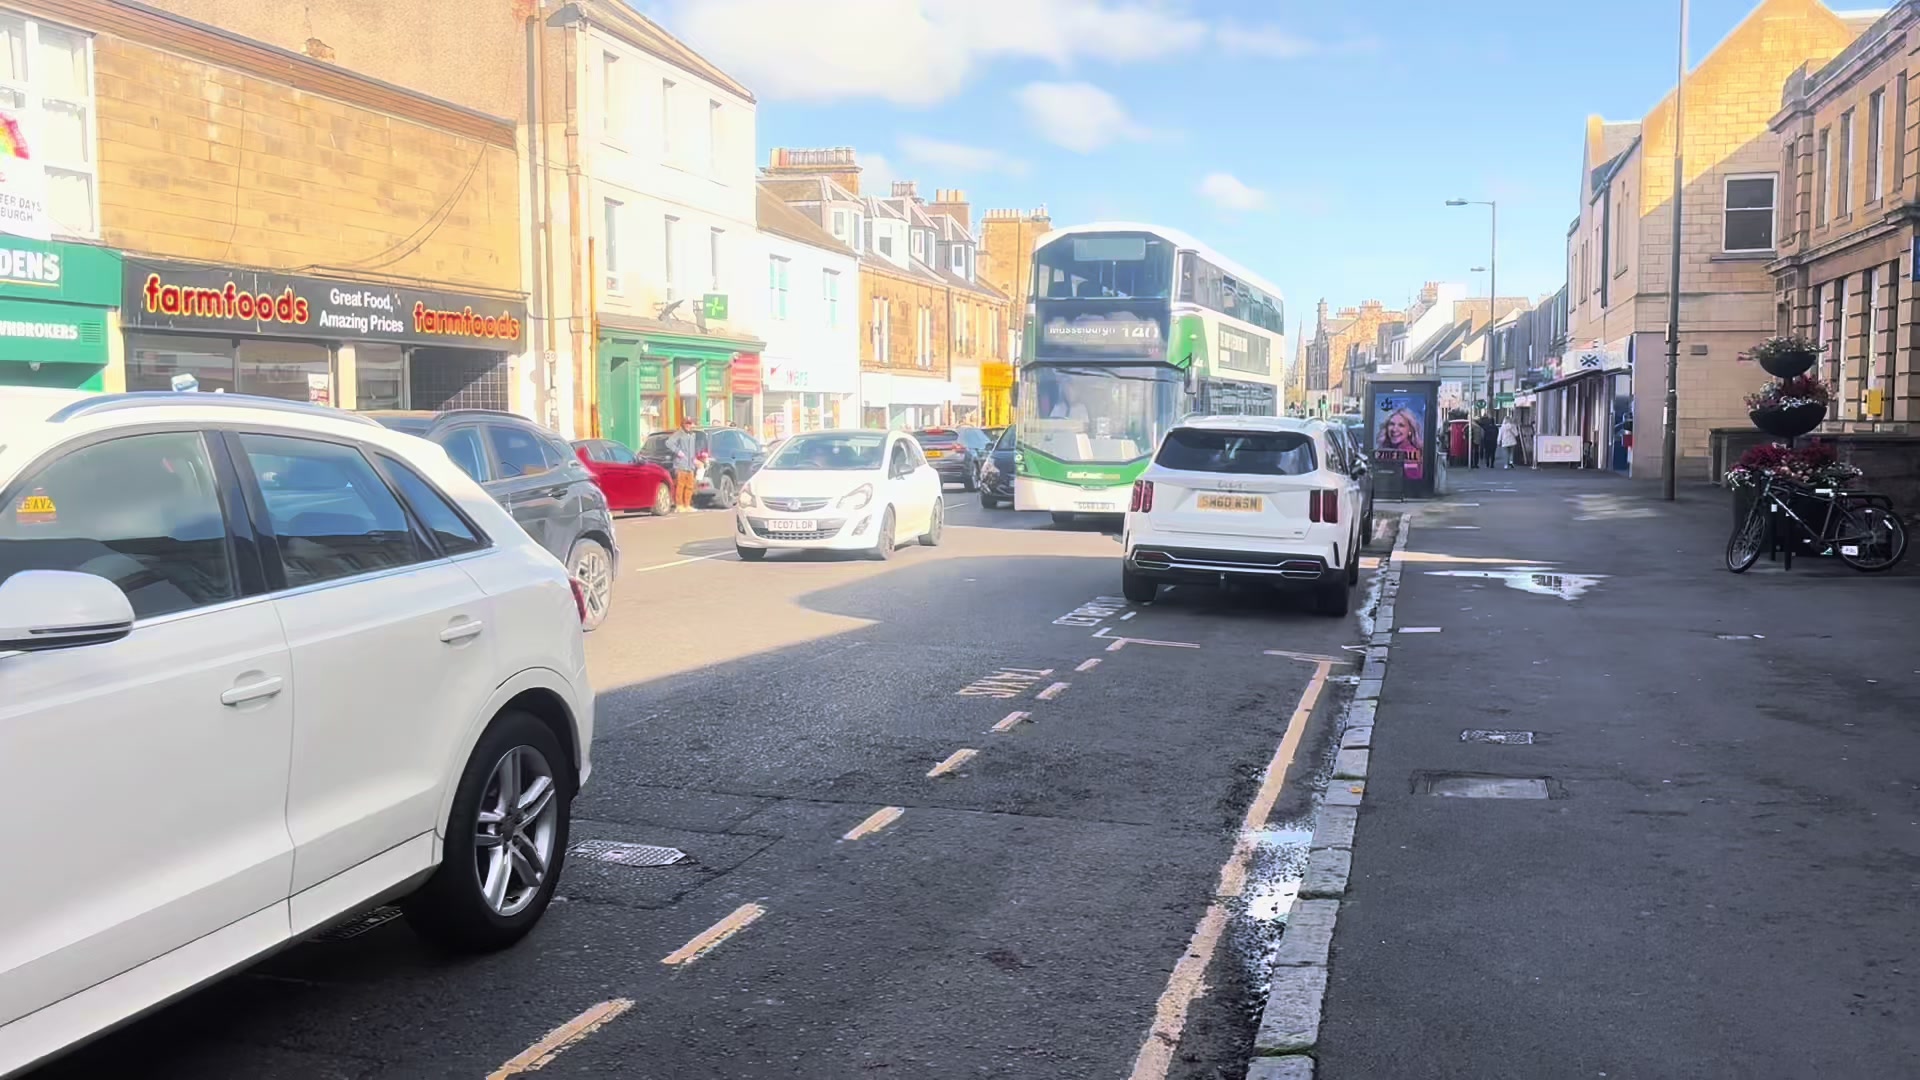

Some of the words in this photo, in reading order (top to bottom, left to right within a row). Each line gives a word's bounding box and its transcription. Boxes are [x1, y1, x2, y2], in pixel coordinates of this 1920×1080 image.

[19, 197, 42, 212] DAYS
[144, 273, 309, 325] farmfoods
[330, 288, 362, 307] Great
[363, 291, 394, 313] Food,
[319, 309, 368, 333] Amazing
[369, 316, 404, 333] Prices
[412, 300, 521, 341] farmfoods
